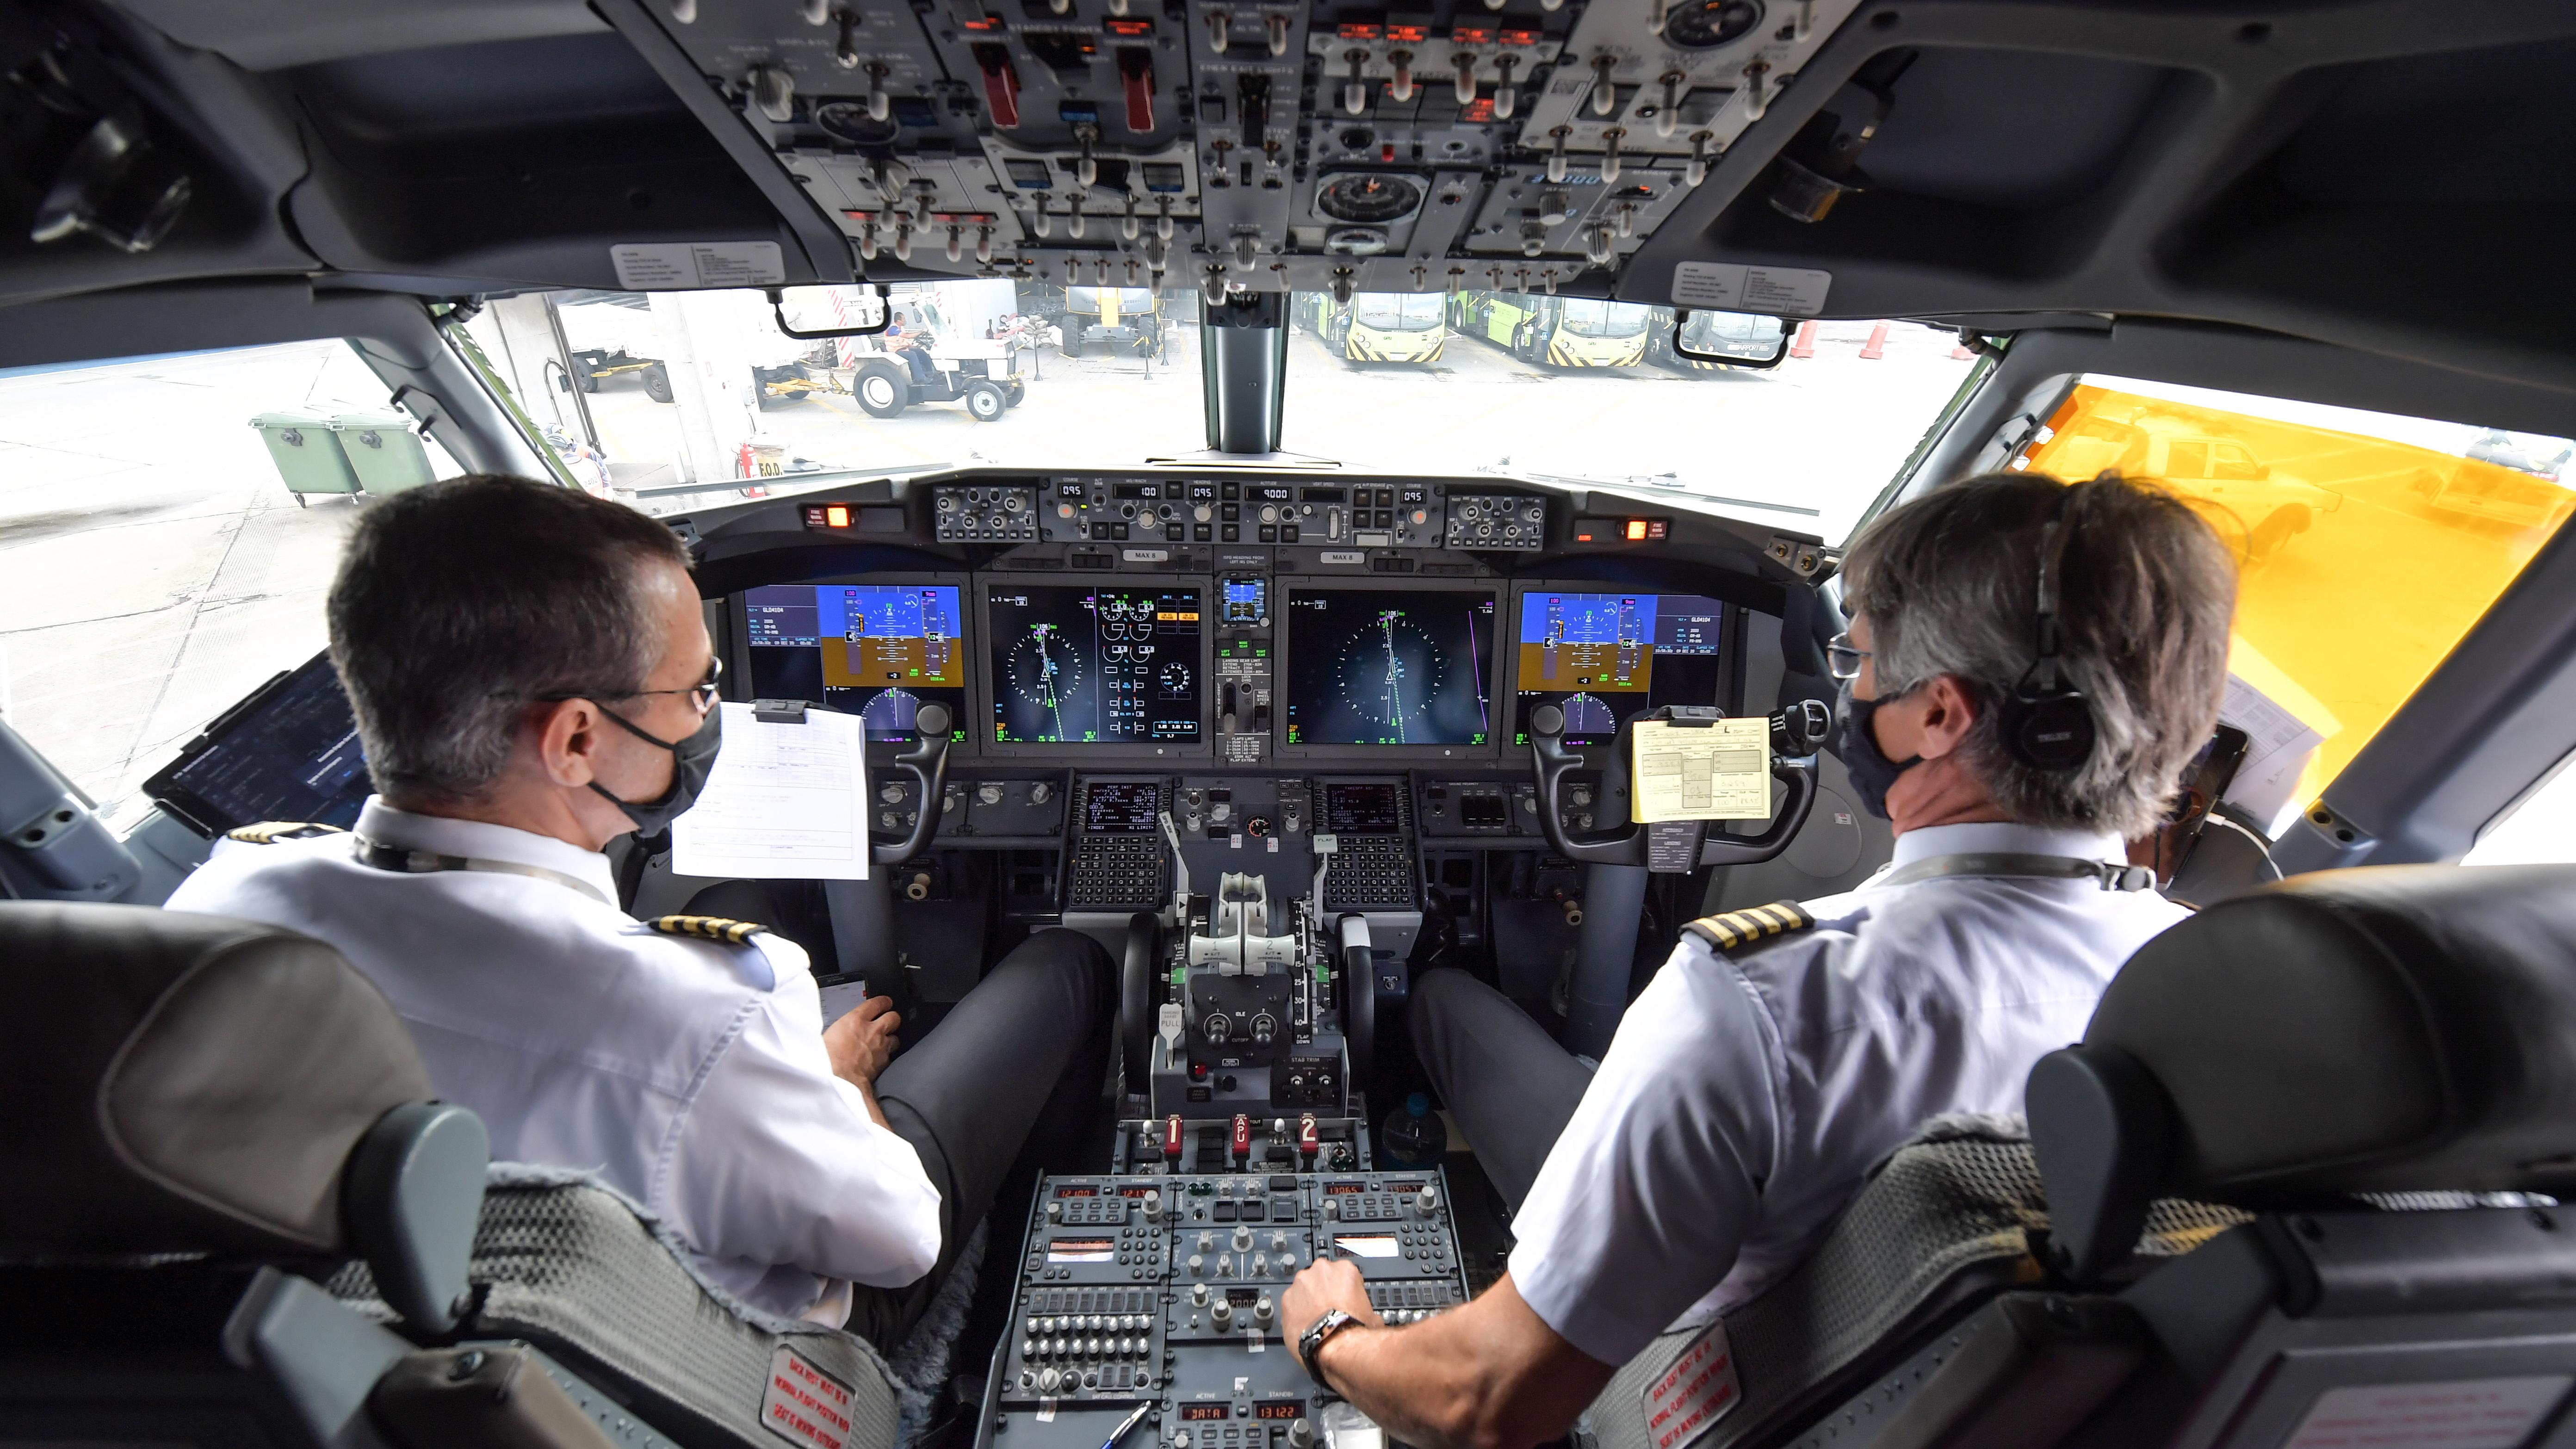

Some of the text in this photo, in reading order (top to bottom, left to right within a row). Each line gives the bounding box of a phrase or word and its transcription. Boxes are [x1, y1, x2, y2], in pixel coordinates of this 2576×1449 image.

[1063, 486, 1081, 495] 095
[1141, 487, 1156, 496] 100
[1194, 488, 1212, 497] 095
[1263, 489, 1287, 499] 9000
[1404, 492, 1421, 501] 095
[1212, 941, 1218, 951] 1
[1266, 940, 1273, 950] 2
[1170, 1120, 1176, 1143] 1
[1302, 1119, 1316, 1141] 2
